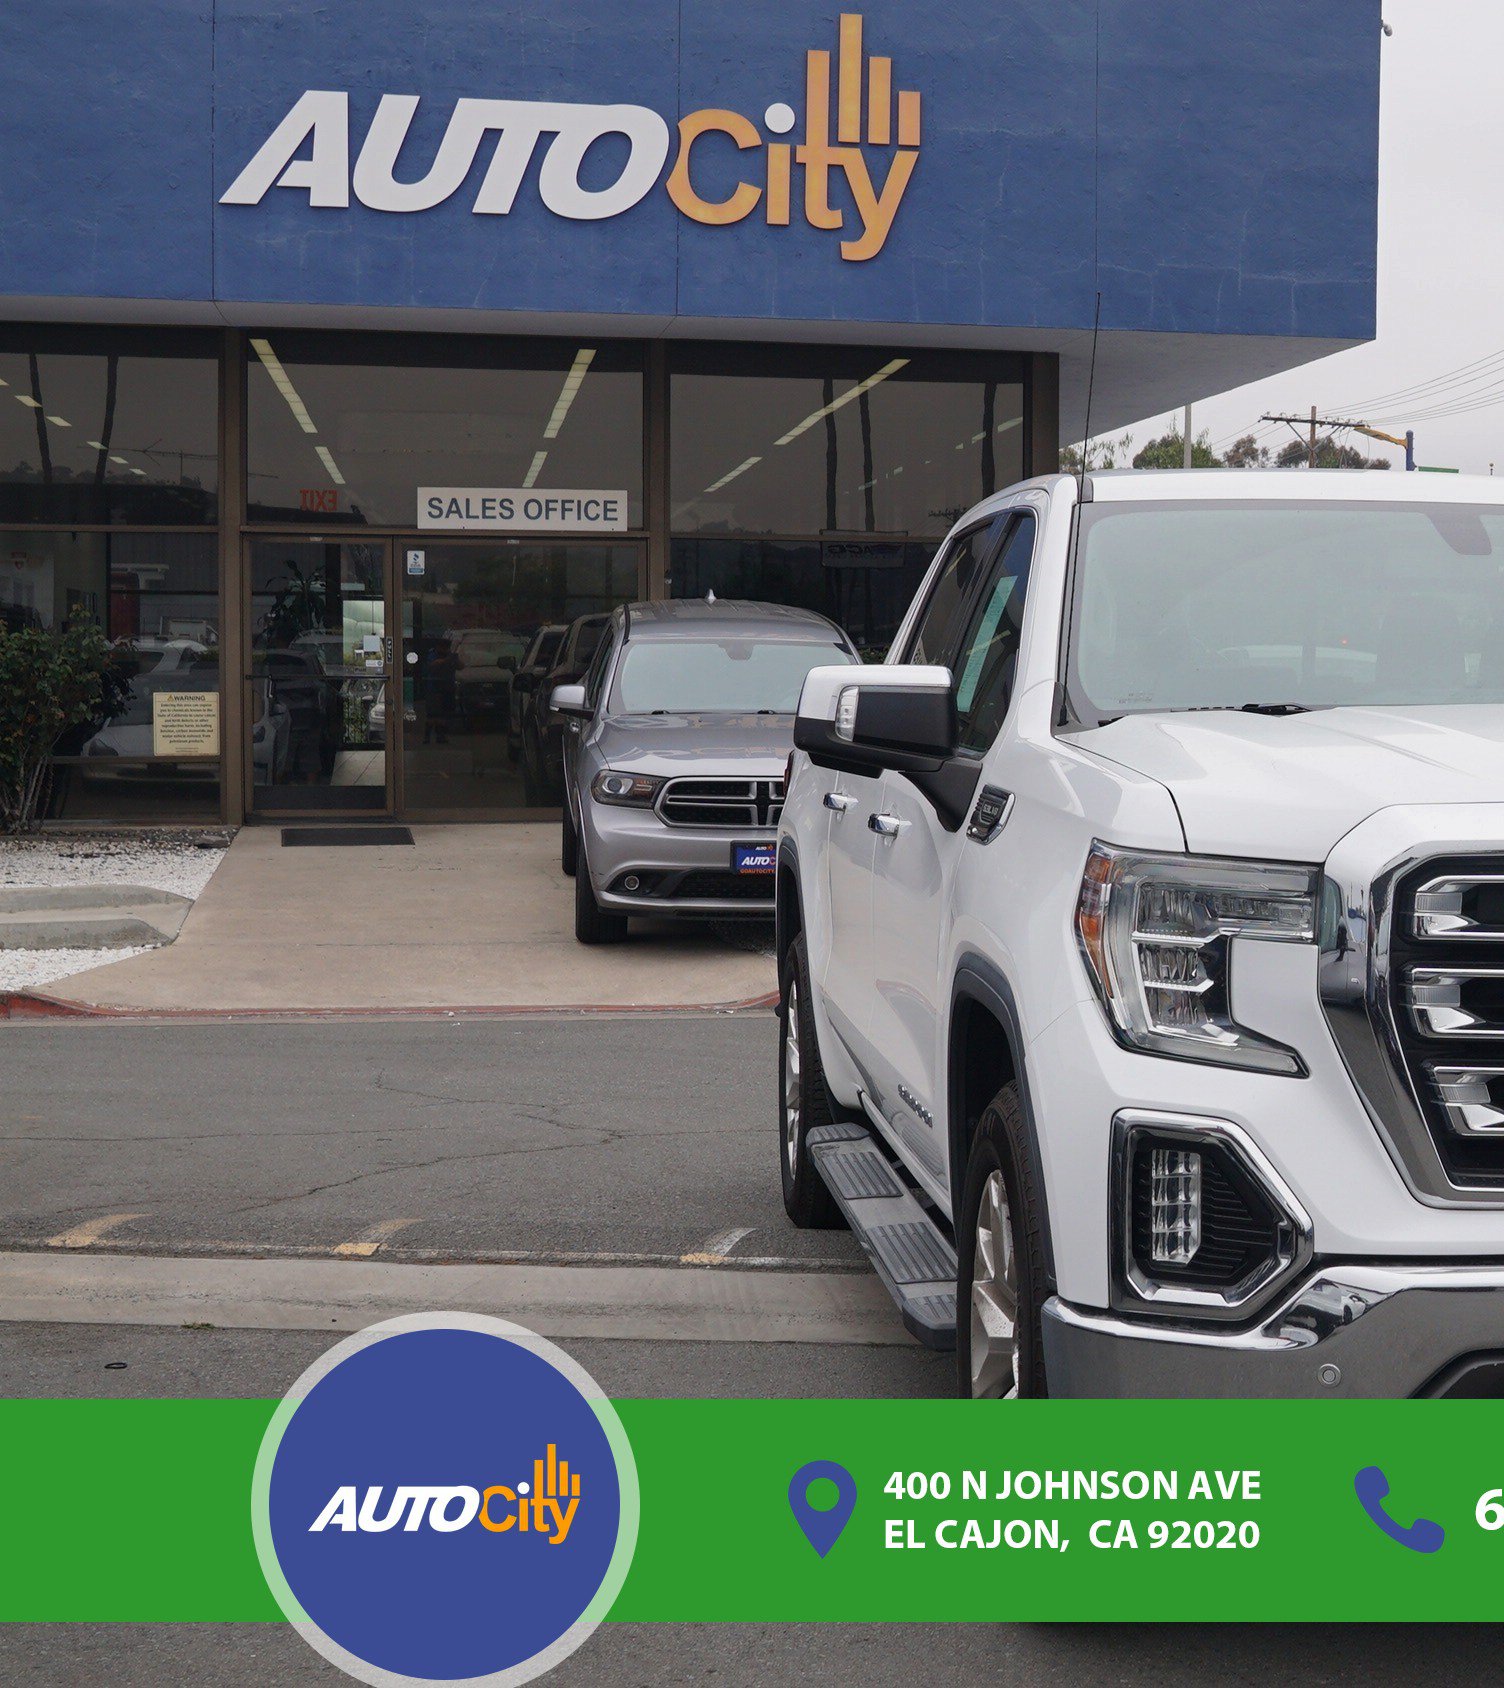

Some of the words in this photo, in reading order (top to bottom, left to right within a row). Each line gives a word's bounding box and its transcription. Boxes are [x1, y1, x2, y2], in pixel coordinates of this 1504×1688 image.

[219, 13, 922, 262] AUTOCity
[427, 497, 515, 520] SALES
[524, 499, 619, 521] OFFICE
